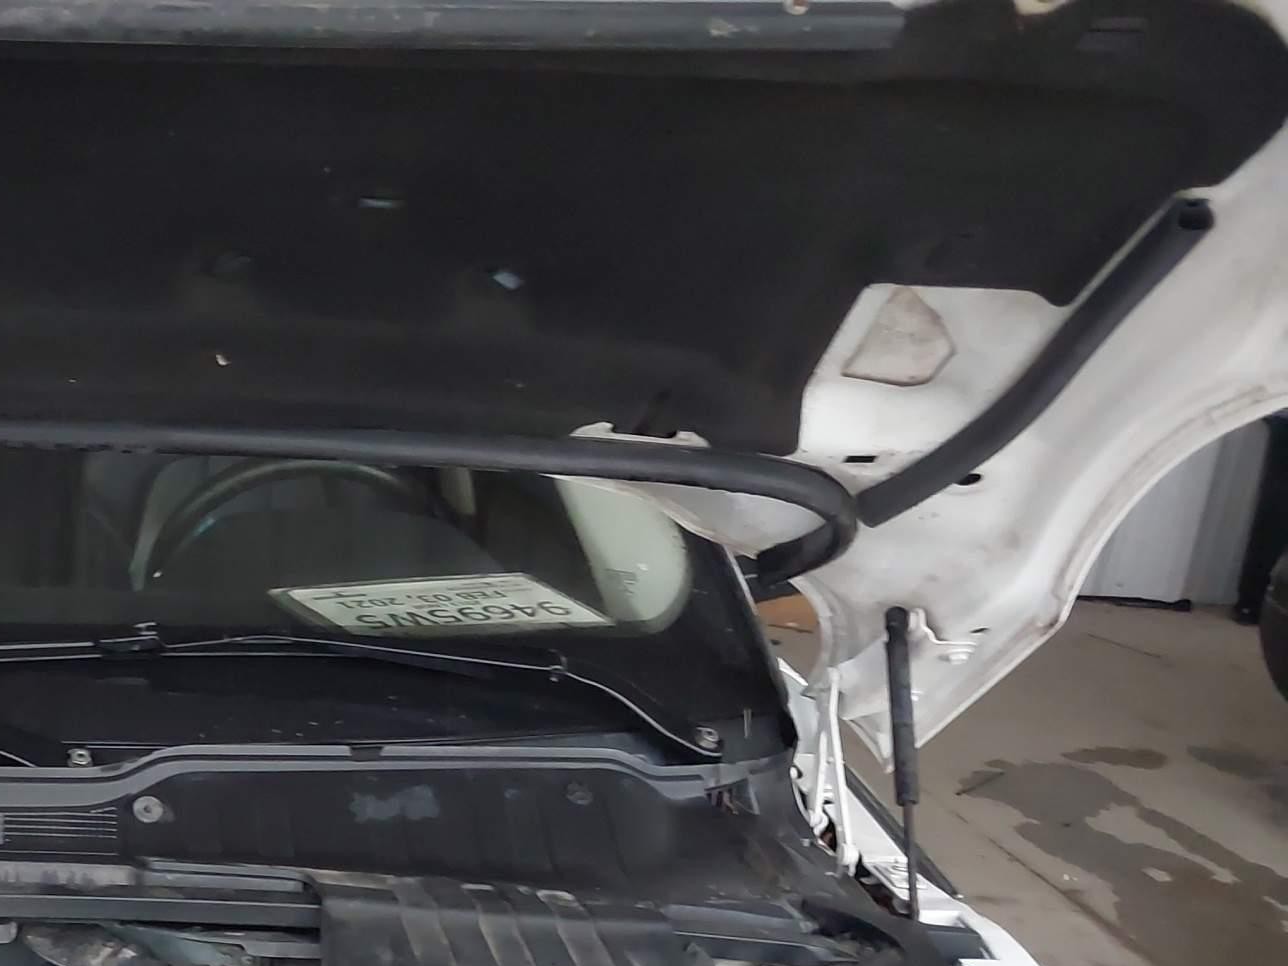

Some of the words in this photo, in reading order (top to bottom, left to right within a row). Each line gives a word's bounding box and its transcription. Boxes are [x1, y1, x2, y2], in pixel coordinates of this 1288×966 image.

[404, 593, 451, 604] 03,
[455, 589, 507, 600] FEB
[335, 597, 397, 609] 2021
